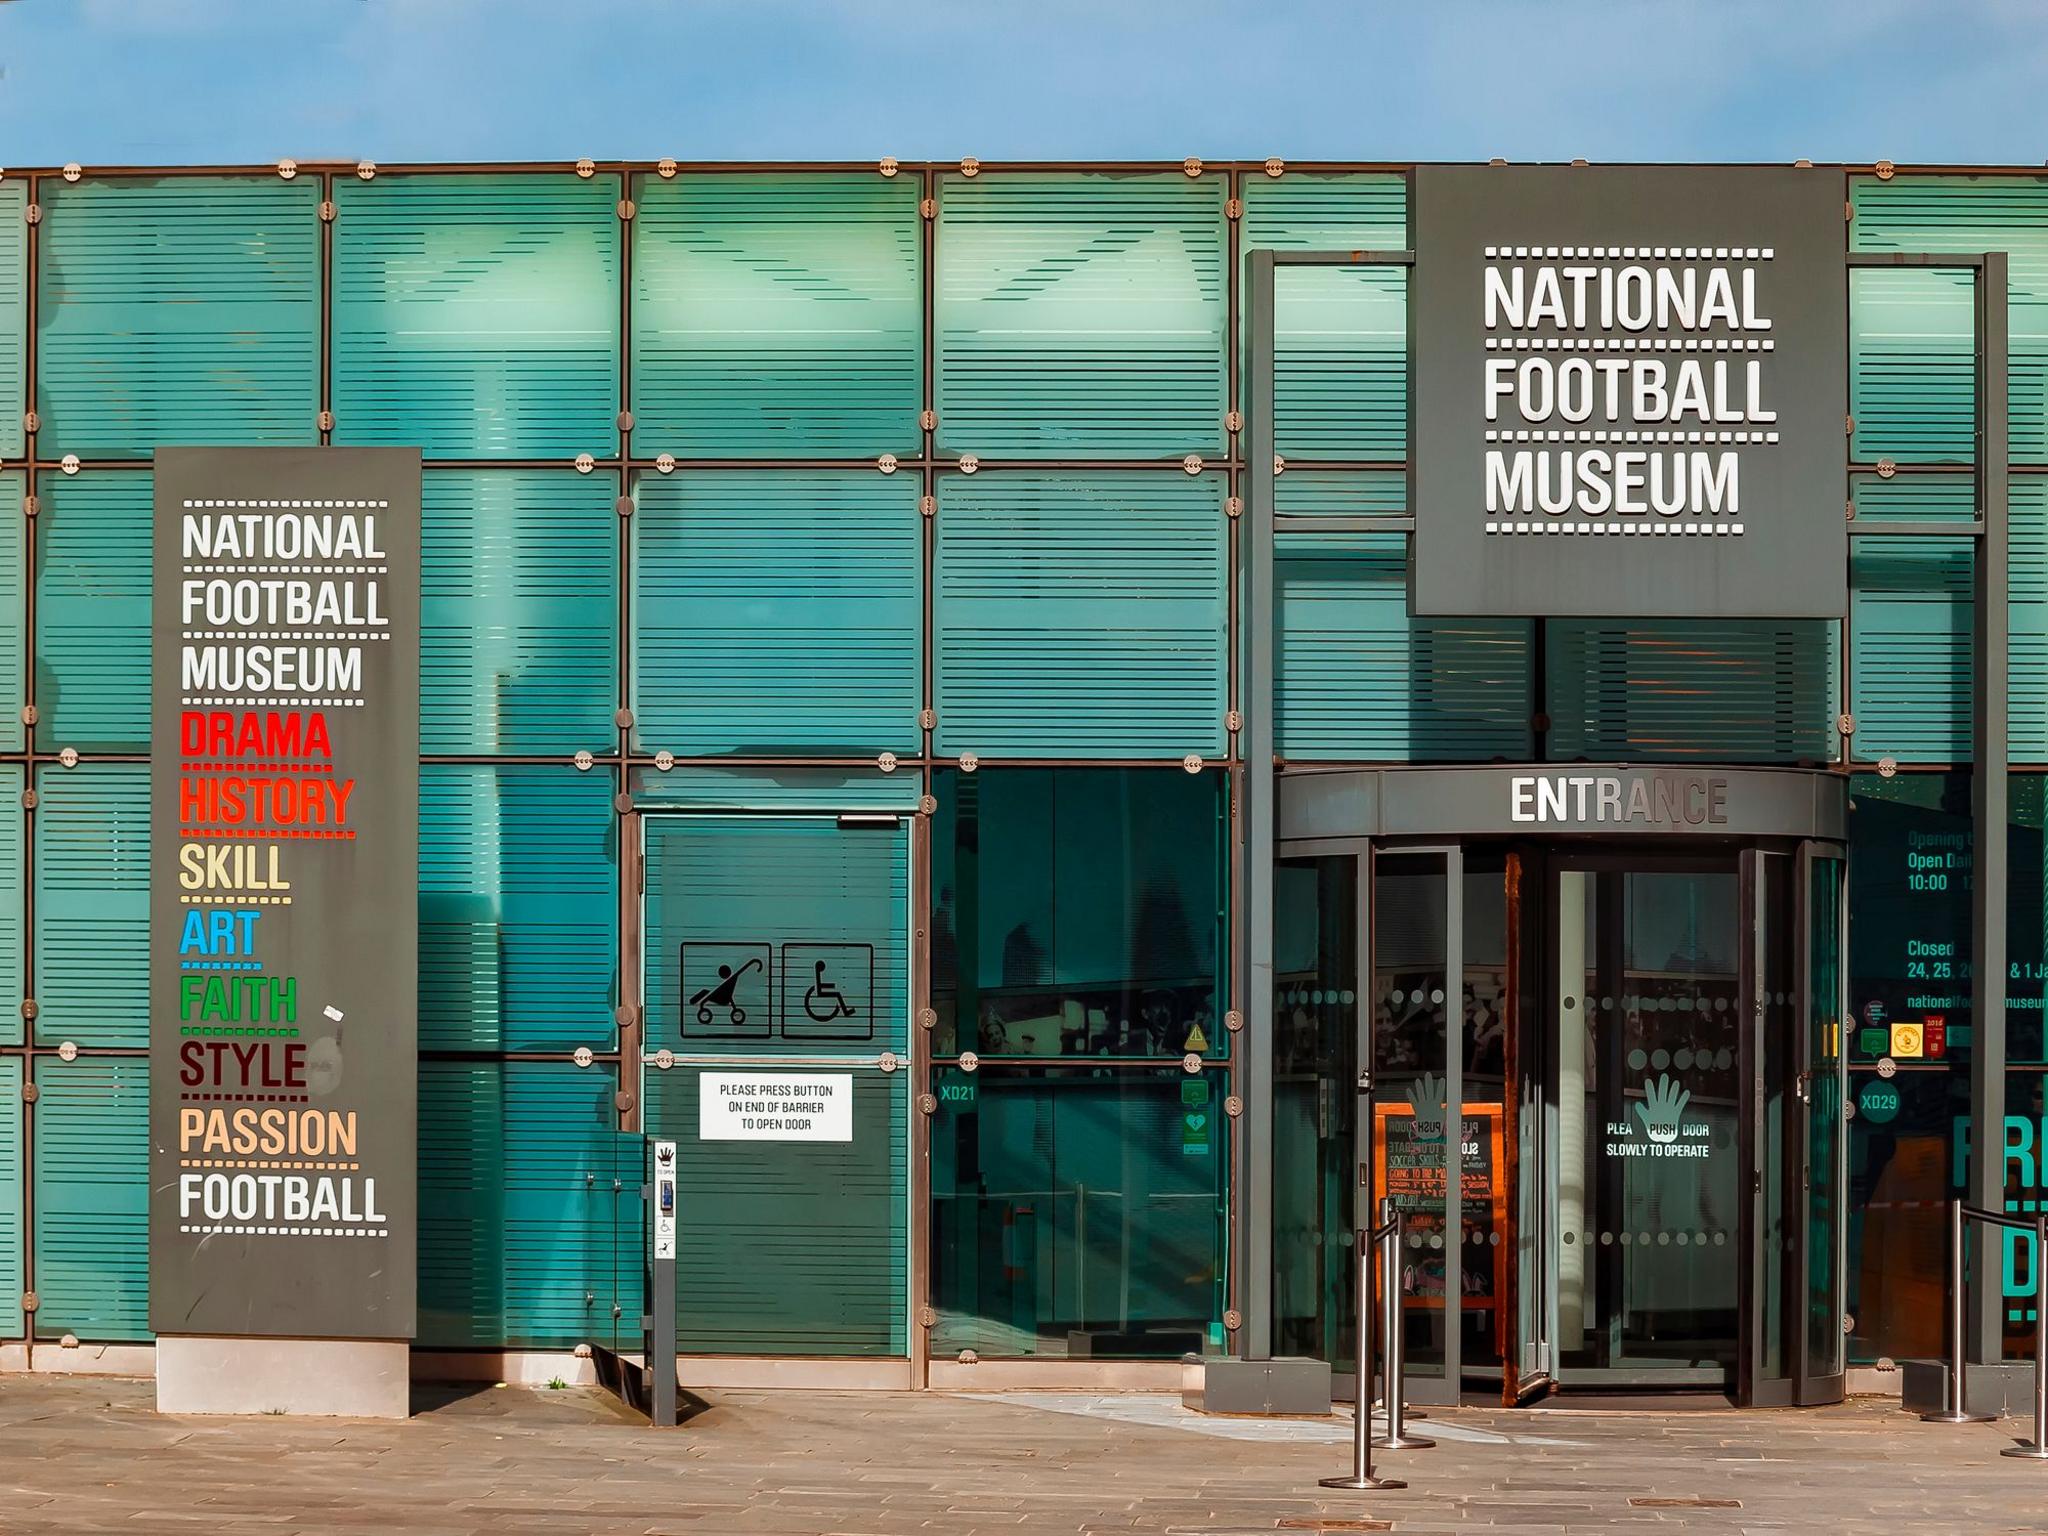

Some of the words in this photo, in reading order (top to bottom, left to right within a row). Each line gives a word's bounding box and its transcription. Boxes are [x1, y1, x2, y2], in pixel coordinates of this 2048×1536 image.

[1485, 266, 1772, 330] NATIONAL
[1485, 357, 1777, 422] FOOTBALL
[1485, 450, 1739, 515] MUSEUM
[183, 514, 386, 559] NATIONAL
[183, 579, 389, 625] FOOTBALL
[182, 646, 362, 692] MUSEUM
[180, 711, 332, 758] DRAMA
[179, 777, 355, 825] HISTORY
[1511, 776, 1728, 824] ENTRANCE
[1908, 831, 1964, 850] Opening
[1908, 852, 1943, 871] Open
[179, 843, 291, 890] SKILL
[1908, 874, 1947, 890] 10:00
[179, 910, 261, 955] ART
[1908, 940, 1955, 956] Closed
[1907, 962, 1929, 980] 24,
[2010, 962, 2021, 978] &
[2025, 962, 2031, 978] 1
[180, 976, 297, 1022] FAITH
[180, 1040, 307, 1088] STYLE
[720, 1084, 757, 1096] PLEASE
[759, 1085, 791, 1097] PRESS
[793, 1085, 833, 1097] BUTTON
[728, 1101, 744, 1113] ON
[745, 1101, 765, 1113] END
[767, 1102, 780, 1113] OF
[782, 1102, 824, 1113] BARRIER
[180, 1108, 357, 1156] PASSION
[741, 1118, 754, 1129] TO
[756, 1118, 782, 1130] OPEN
[785, 1119, 811, 1130] DOOR
[1650, 1123, 1676, 1135] PUSH
[1682, 1124, 1710, 1137] DOOR
[1606, 1144, 1648, 1157] SLOWLY
[1649, 1144, 1663, 1157] TO
[1664, 1144, 1710, 1158] OPERATE
[180, 1173, 387, 1222] FOOTBALL
